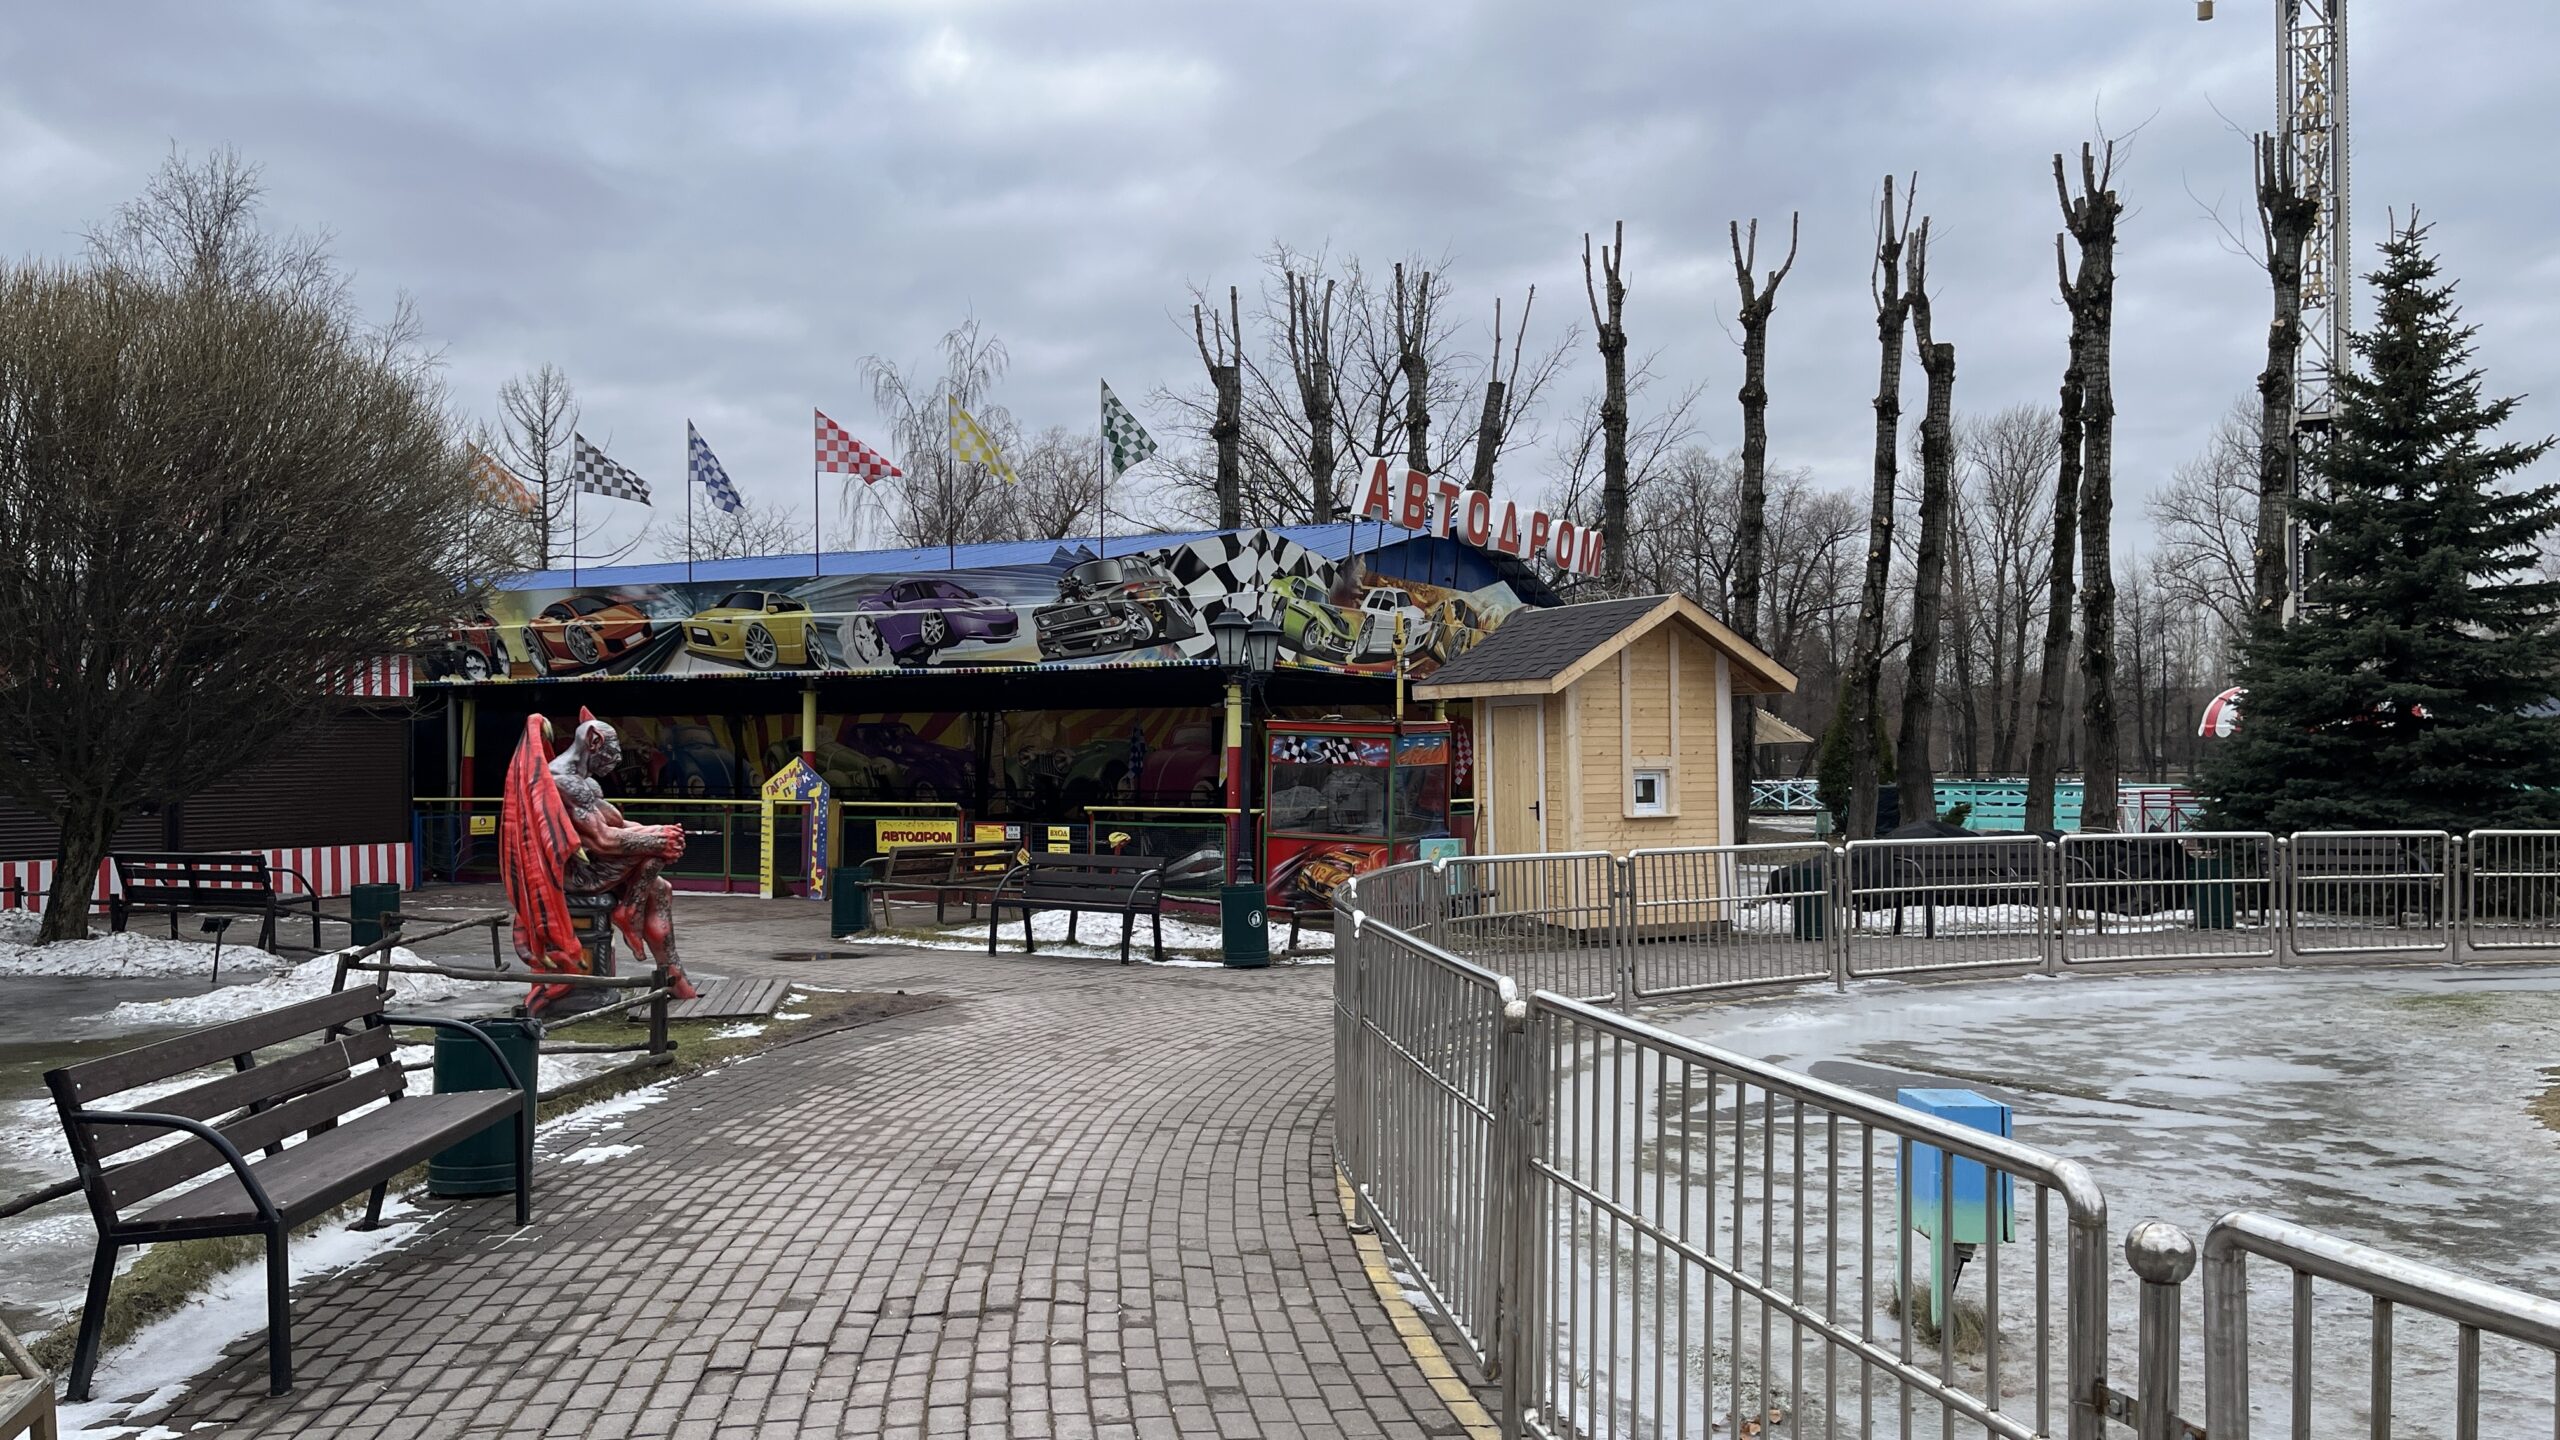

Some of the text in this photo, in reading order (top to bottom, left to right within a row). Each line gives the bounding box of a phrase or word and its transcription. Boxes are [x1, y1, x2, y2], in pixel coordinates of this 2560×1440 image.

[1351, 457, 1604, 577] АВТОДРОМ
[766, 762, 804, 796] ГАГАРИН
[783, 772, 811, 798] ПАРК
[881, 831, 953, 843] АВТОДРОМ
